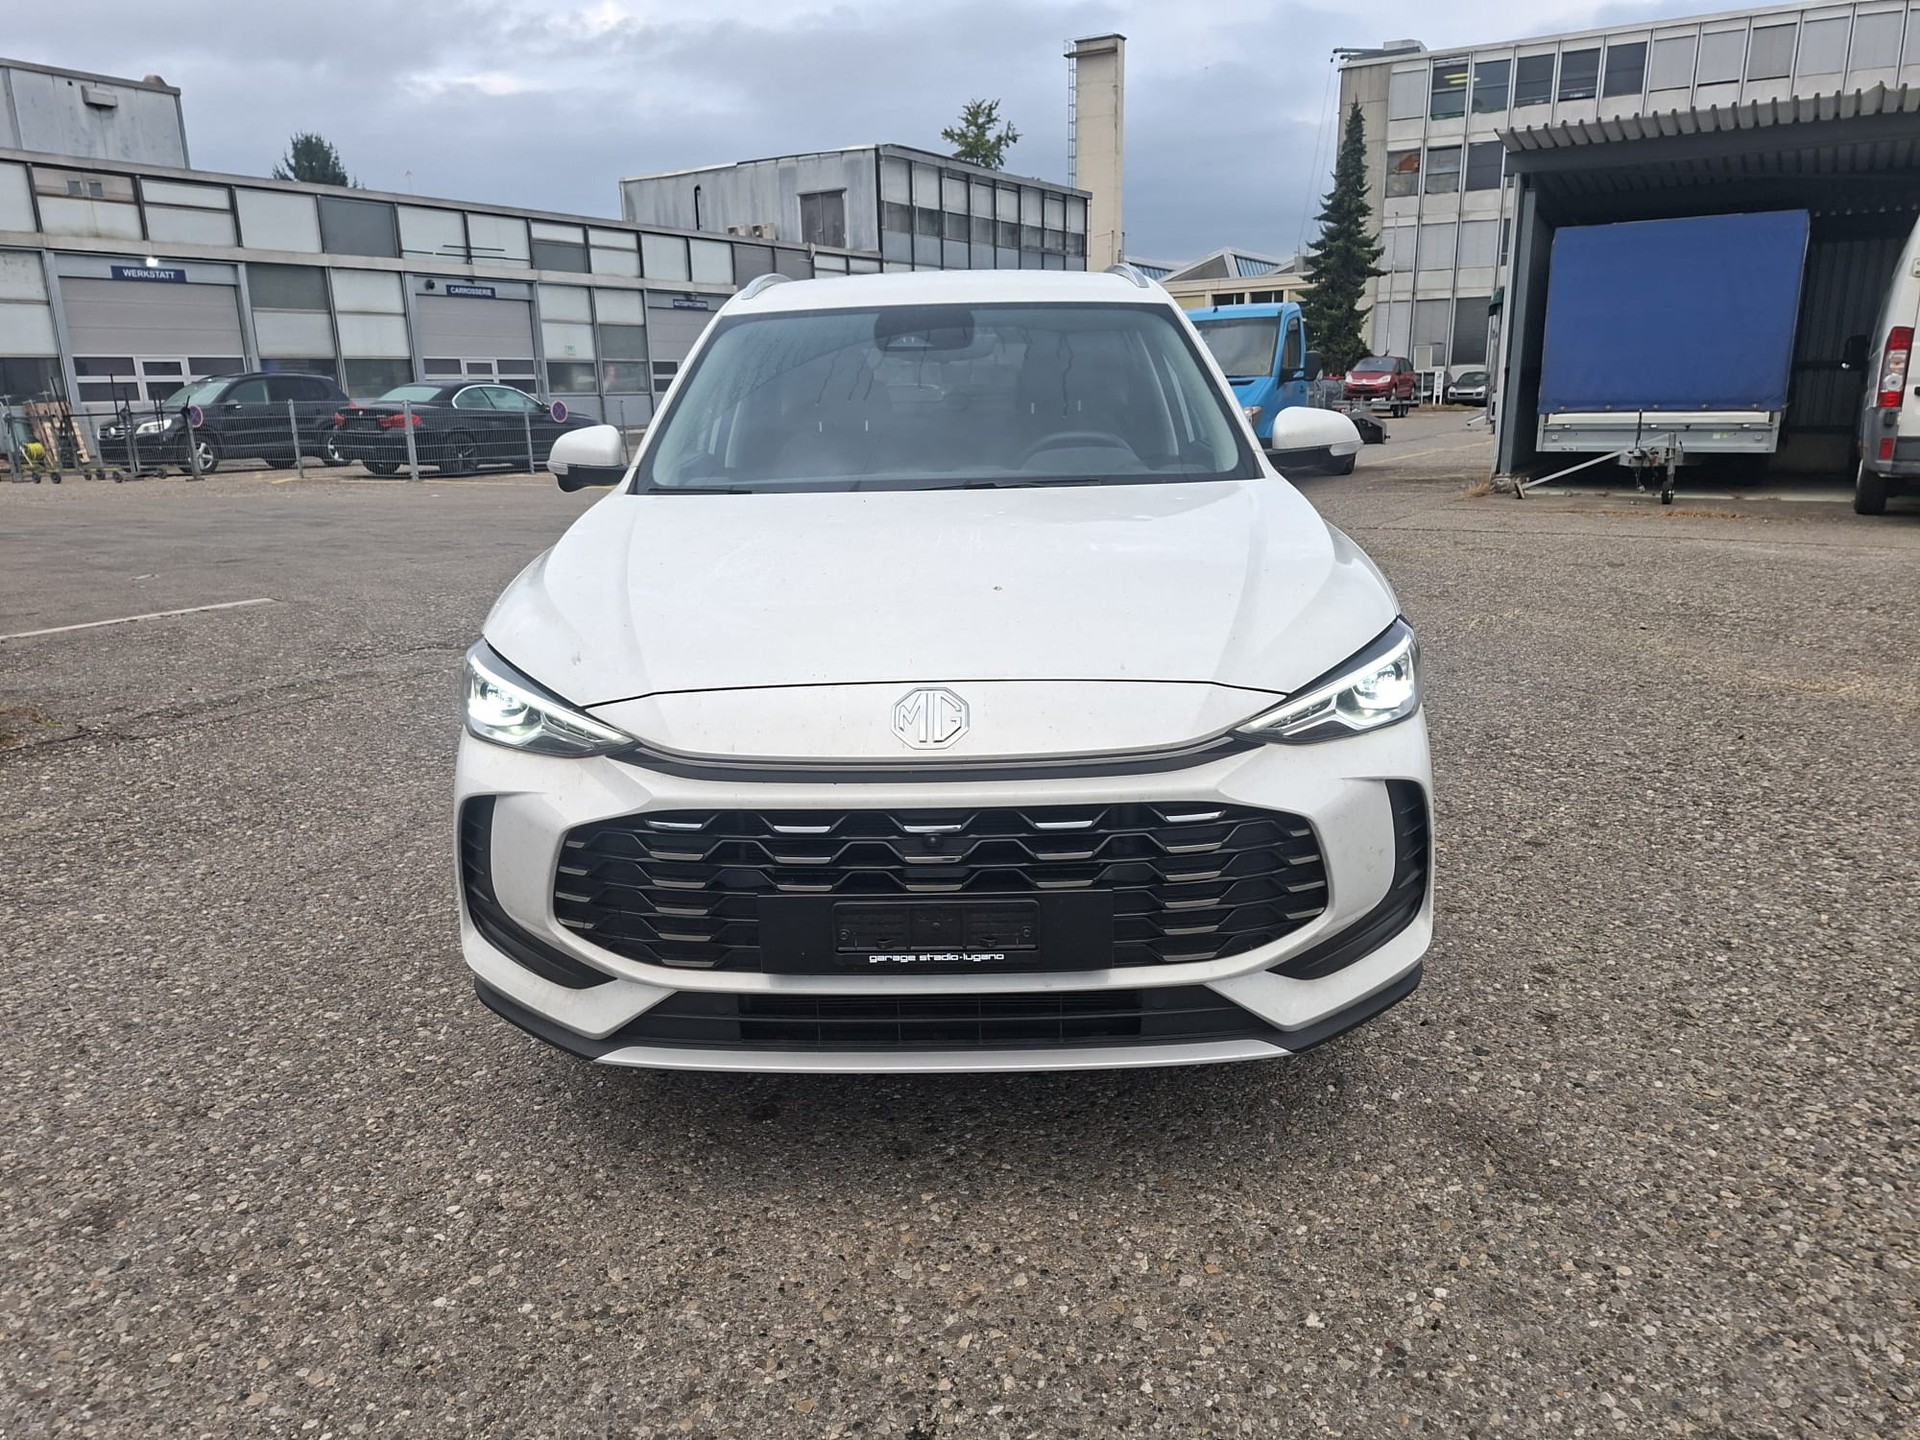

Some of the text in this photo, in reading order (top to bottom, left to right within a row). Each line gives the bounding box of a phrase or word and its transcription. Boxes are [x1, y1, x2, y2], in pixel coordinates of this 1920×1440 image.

[122, 268, 175, 279] WERKSTATT
[450, 286, 492, 296] CARROSSERIE
[898, 692, 963, 743] MG
[869, 955, 916, 963] garage
